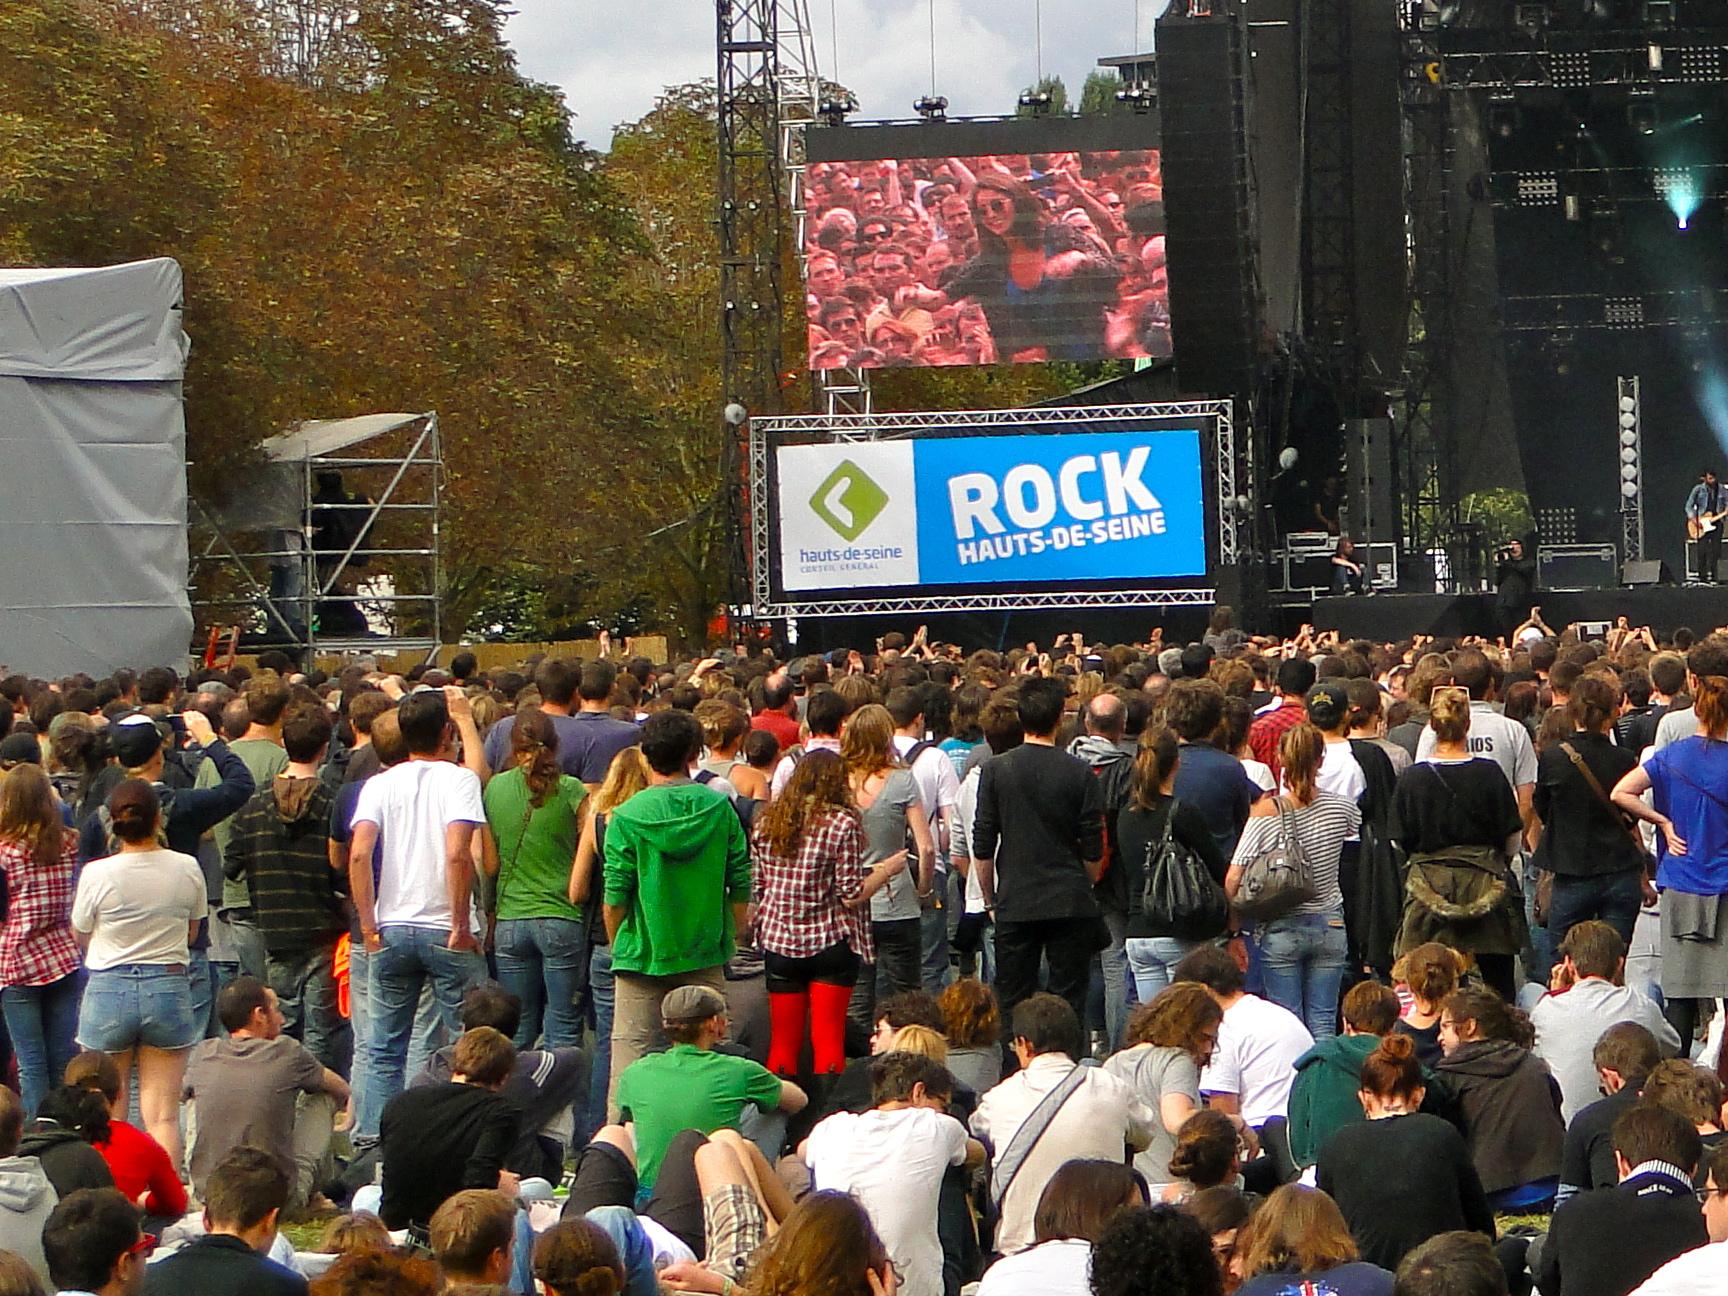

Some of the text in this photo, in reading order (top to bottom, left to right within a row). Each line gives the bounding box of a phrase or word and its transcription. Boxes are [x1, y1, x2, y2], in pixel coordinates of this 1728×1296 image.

[948, 445, 1162, 540] ROCK
[799, 545, 903, 563] hauts-de-seine
[957, 511, 1166, 566] HAUTS-DE-SEINE
